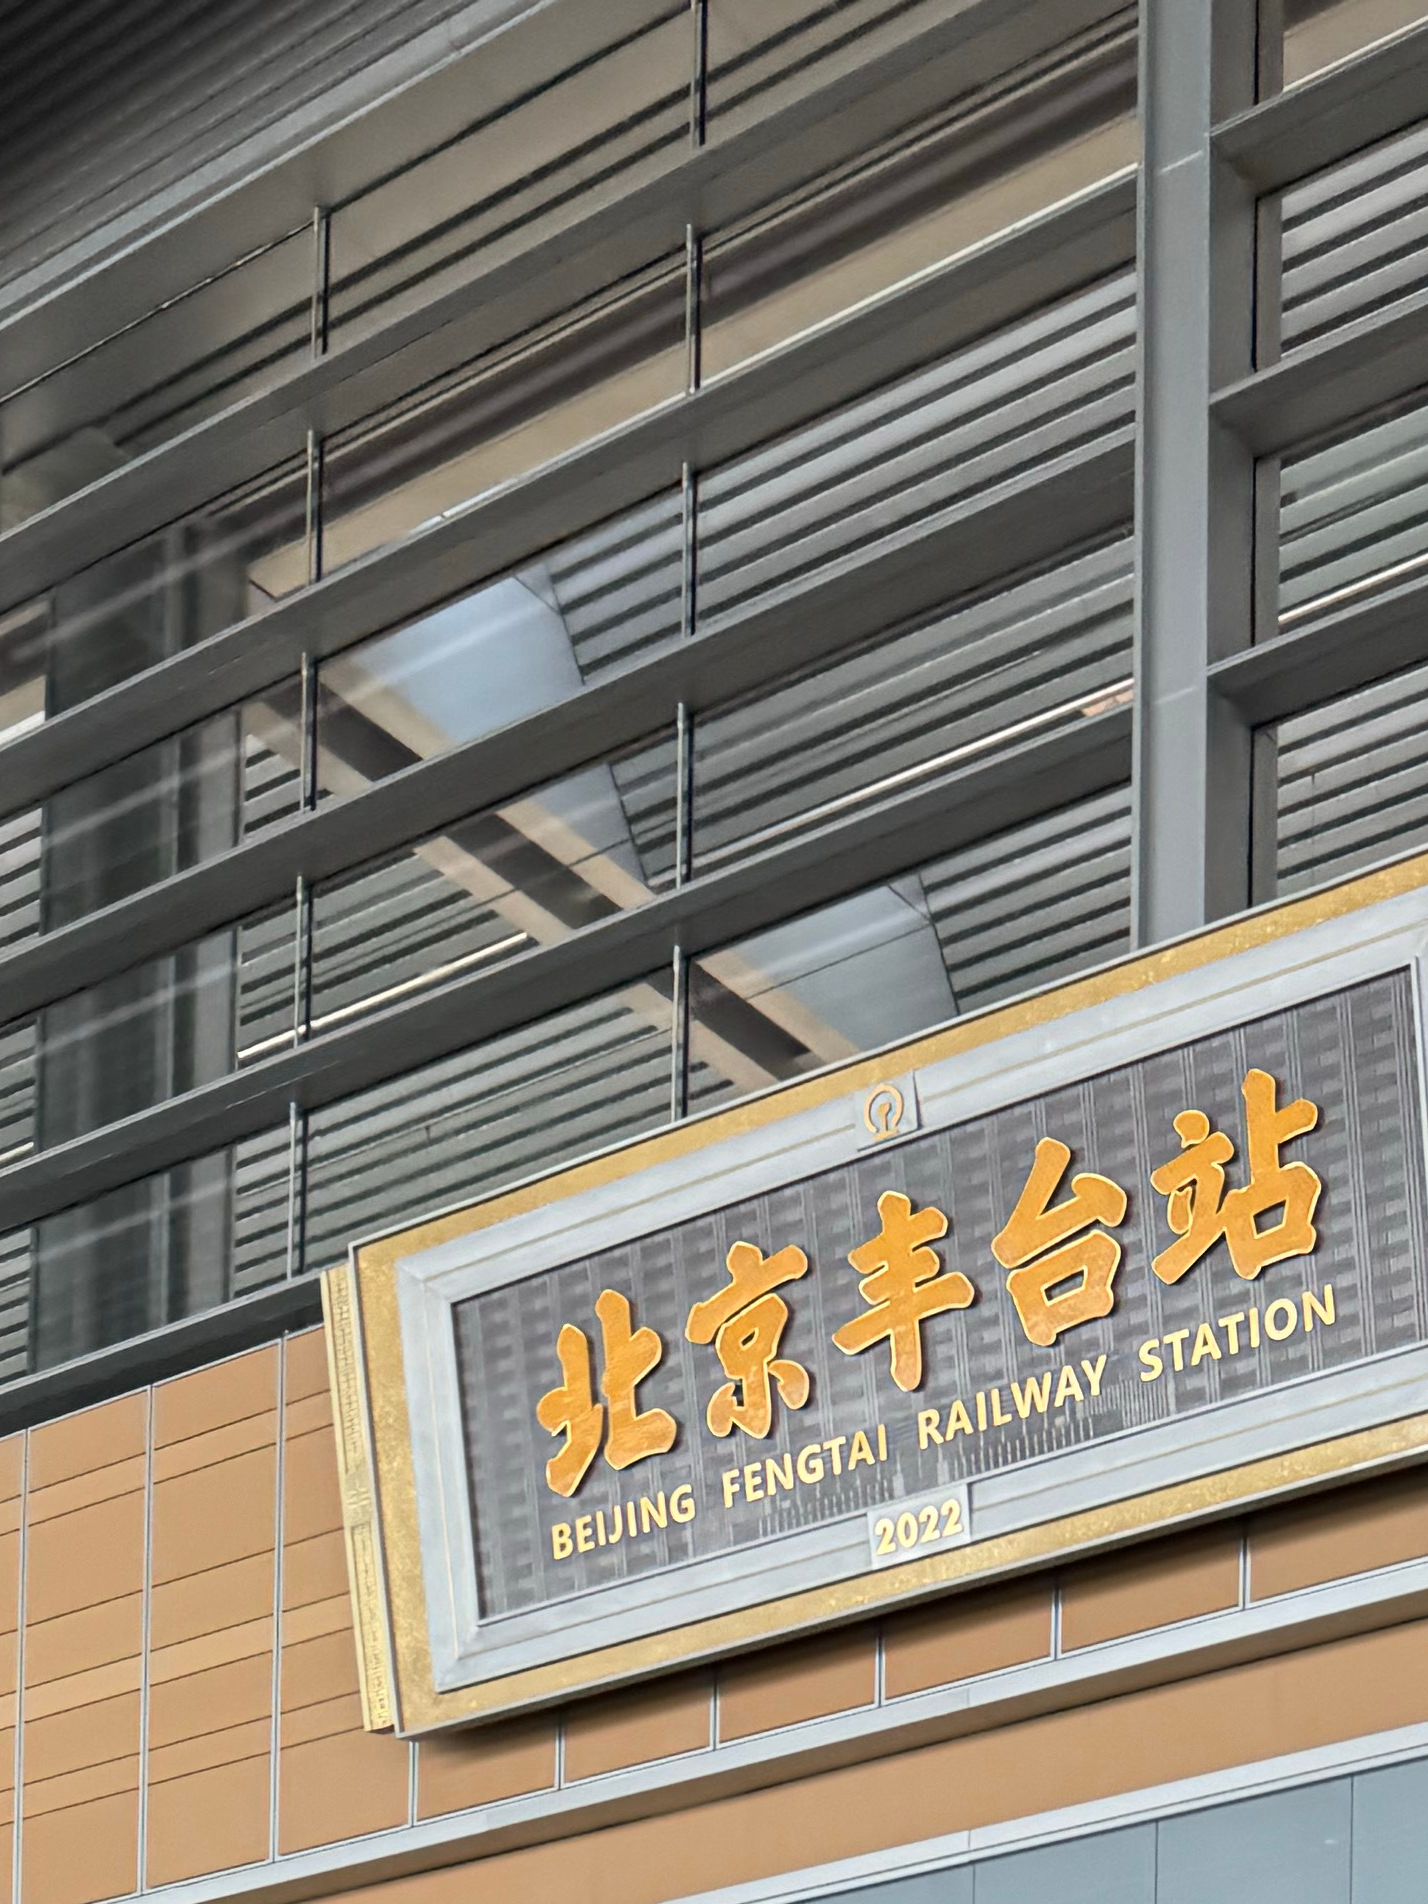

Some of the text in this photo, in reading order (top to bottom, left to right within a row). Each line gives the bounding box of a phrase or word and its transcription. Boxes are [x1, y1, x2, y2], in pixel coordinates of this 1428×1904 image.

[537, 1068, 1321, 1497] 北京丰台站
[551, 1284, 1336, 1559] BEIJING FENGTAI RAILWAY STATION
[875, 1498, 962, 1556] 2022
